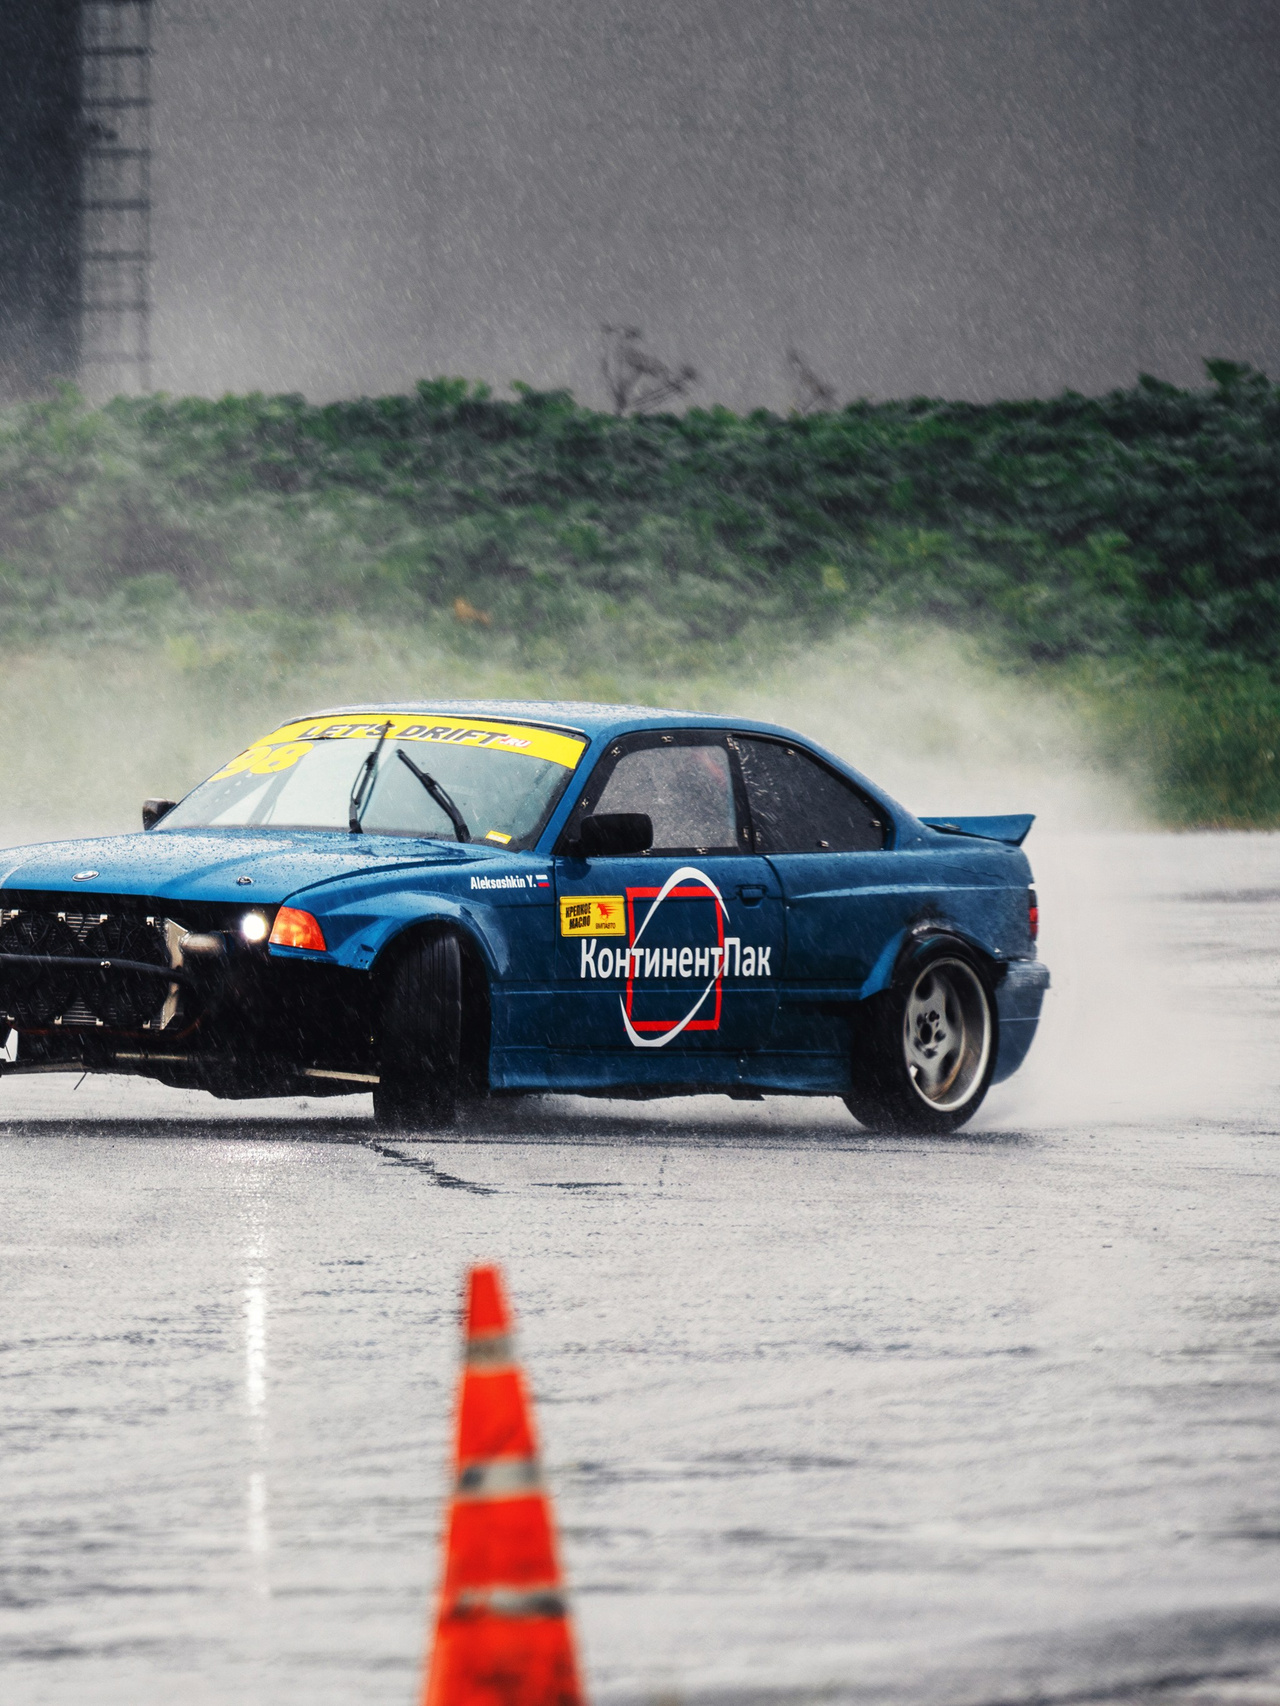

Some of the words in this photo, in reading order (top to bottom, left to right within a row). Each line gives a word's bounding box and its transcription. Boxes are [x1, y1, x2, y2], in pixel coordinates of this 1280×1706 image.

[296, 723, 396, 738] LET'S
[207, 742, 314, 782] 98
[471, 875, 526, 889] Aleksashkin
[526, 875, 537, 888] Y.
[566, 903, 591, 918] КРЕПКОЕ
[569, 915, 591, 930] МАСЛО
[580, 937, 771, 978] КонтинентПак
